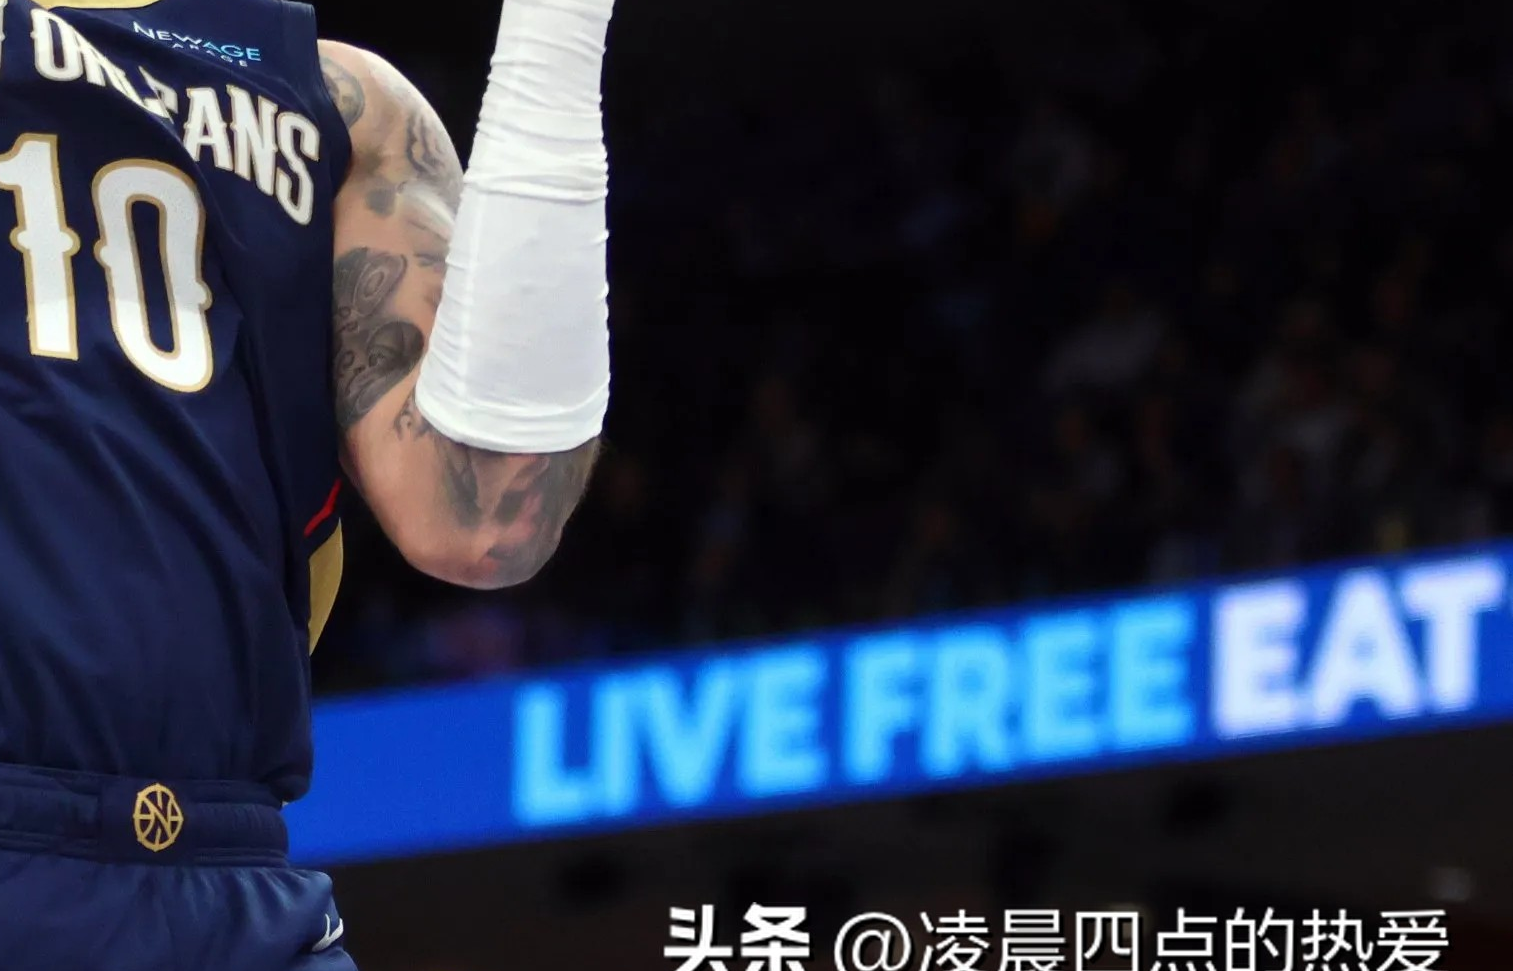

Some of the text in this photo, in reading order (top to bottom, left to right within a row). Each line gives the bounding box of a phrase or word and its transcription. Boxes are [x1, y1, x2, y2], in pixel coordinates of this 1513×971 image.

[133, 21, 262, 61] NEWAGE
[514, 557, 1506, 825] LIVE FREE EAT
